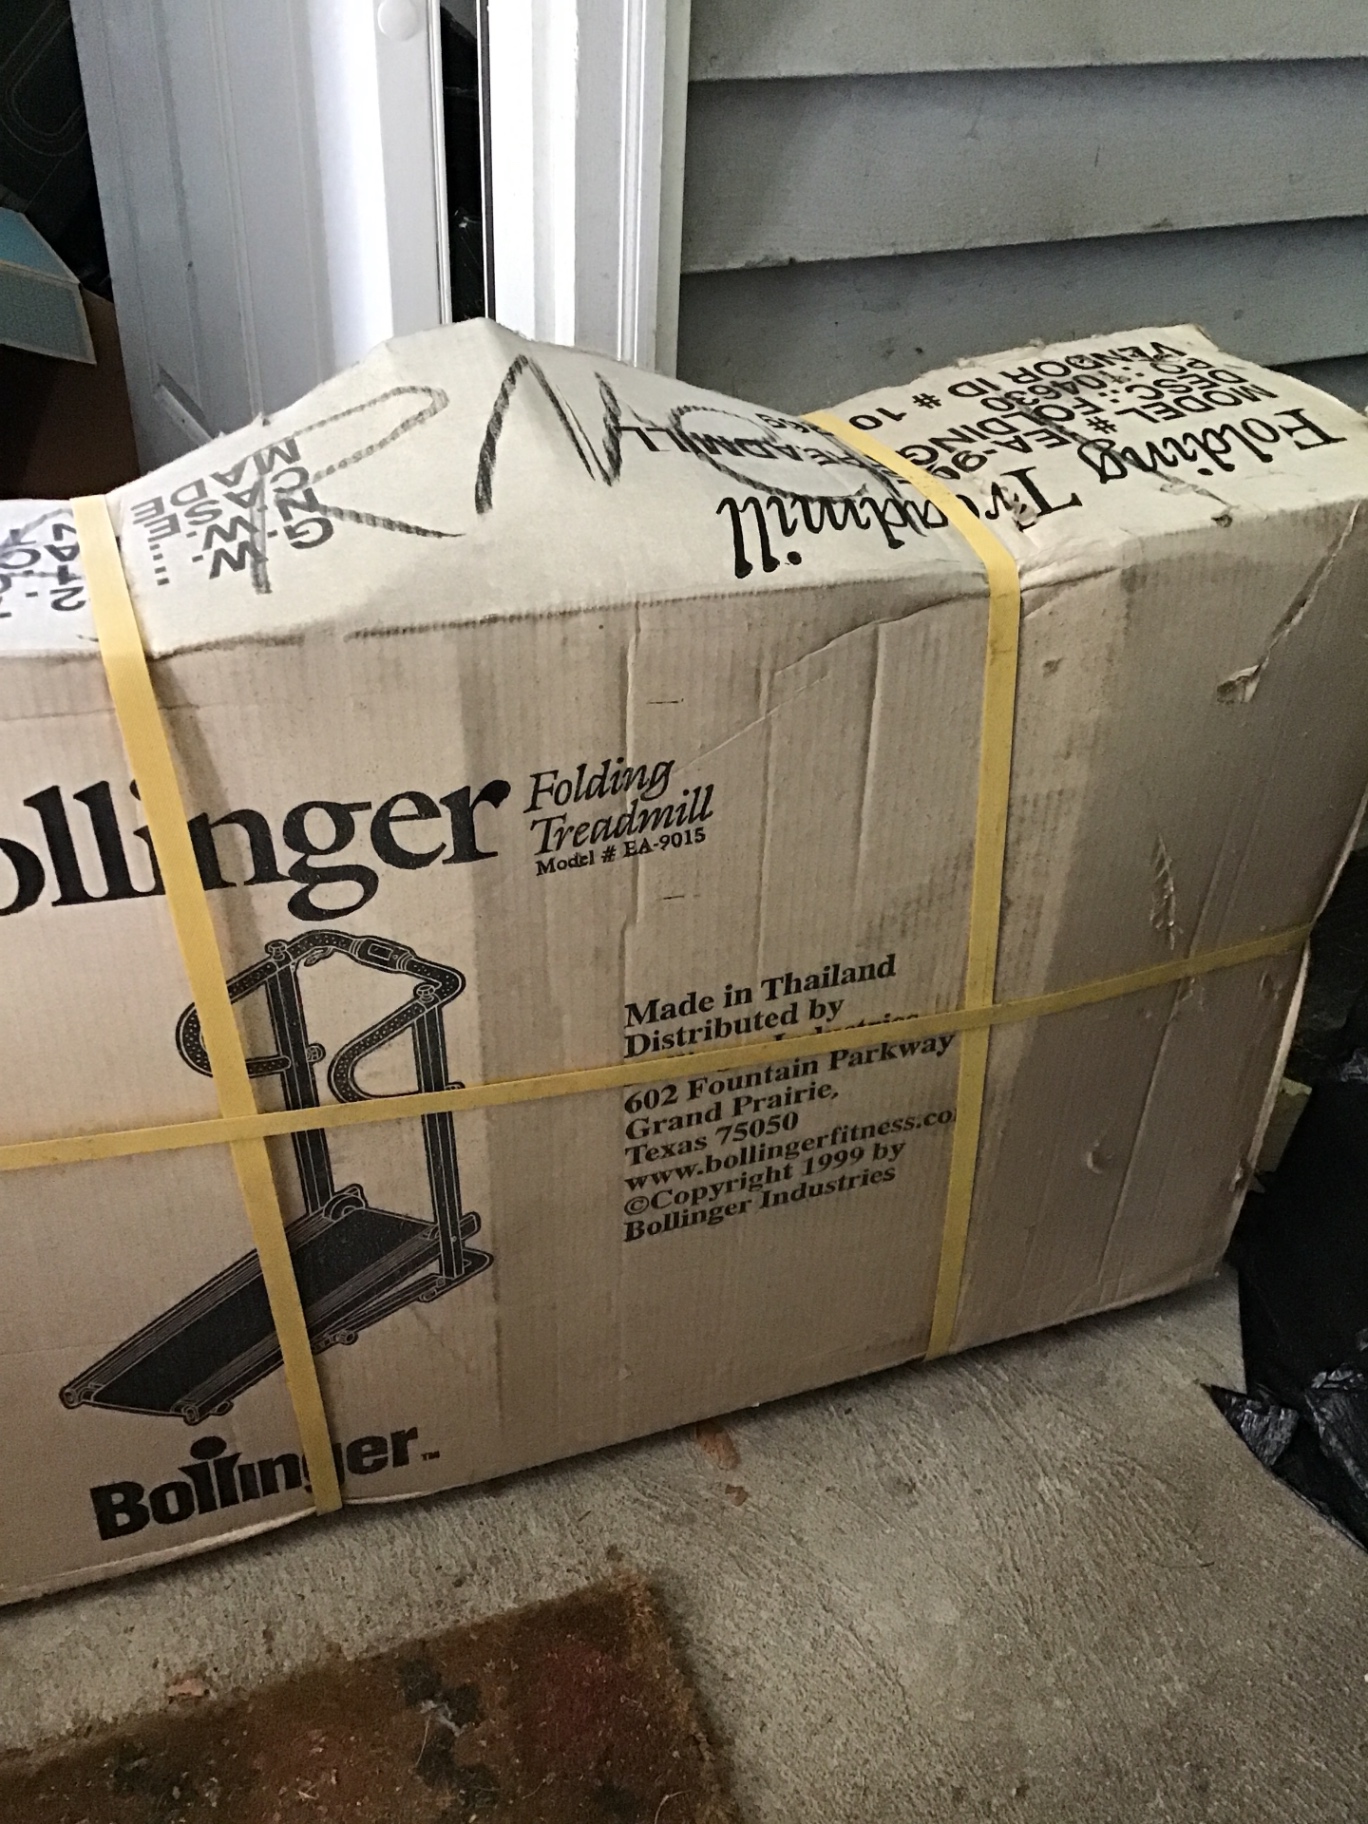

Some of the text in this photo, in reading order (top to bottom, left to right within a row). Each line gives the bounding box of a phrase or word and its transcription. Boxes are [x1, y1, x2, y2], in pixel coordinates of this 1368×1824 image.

[948, 376, 1001, 399] ID
[1000, 341, 1187, 384] VENDOR
[1114, 382, 1280, 424] MODEL
[1077, 407, 1348, 485] Folding
[131, 437, 302, 525] MADE
[144, 466, 311, 542] CASE
[523, 756, 676, 814] Folding
[530, 783, 715, 856] Treadmill
[536, 826, 707, 876] Model # EA-9015
[624, 953, 897, 1030] Made in Thailand
[623, 1003, 798, 1060] Distributed
[808, 998, 845, 1023] by
[624, 1083, 679, 1115] 602
[687, 1056, 819, 1101] Fountain
[829, 1033, 956, 1072] Parkway
[624, 1110, 799, 1168] Texas 75050
[625, 1080, 840, 1141] Grand Prairie,
[623, 1139, 906, 1218] ©Copyright 1999 by
[623, 1165, 897, 1243] Bollinger Industries
